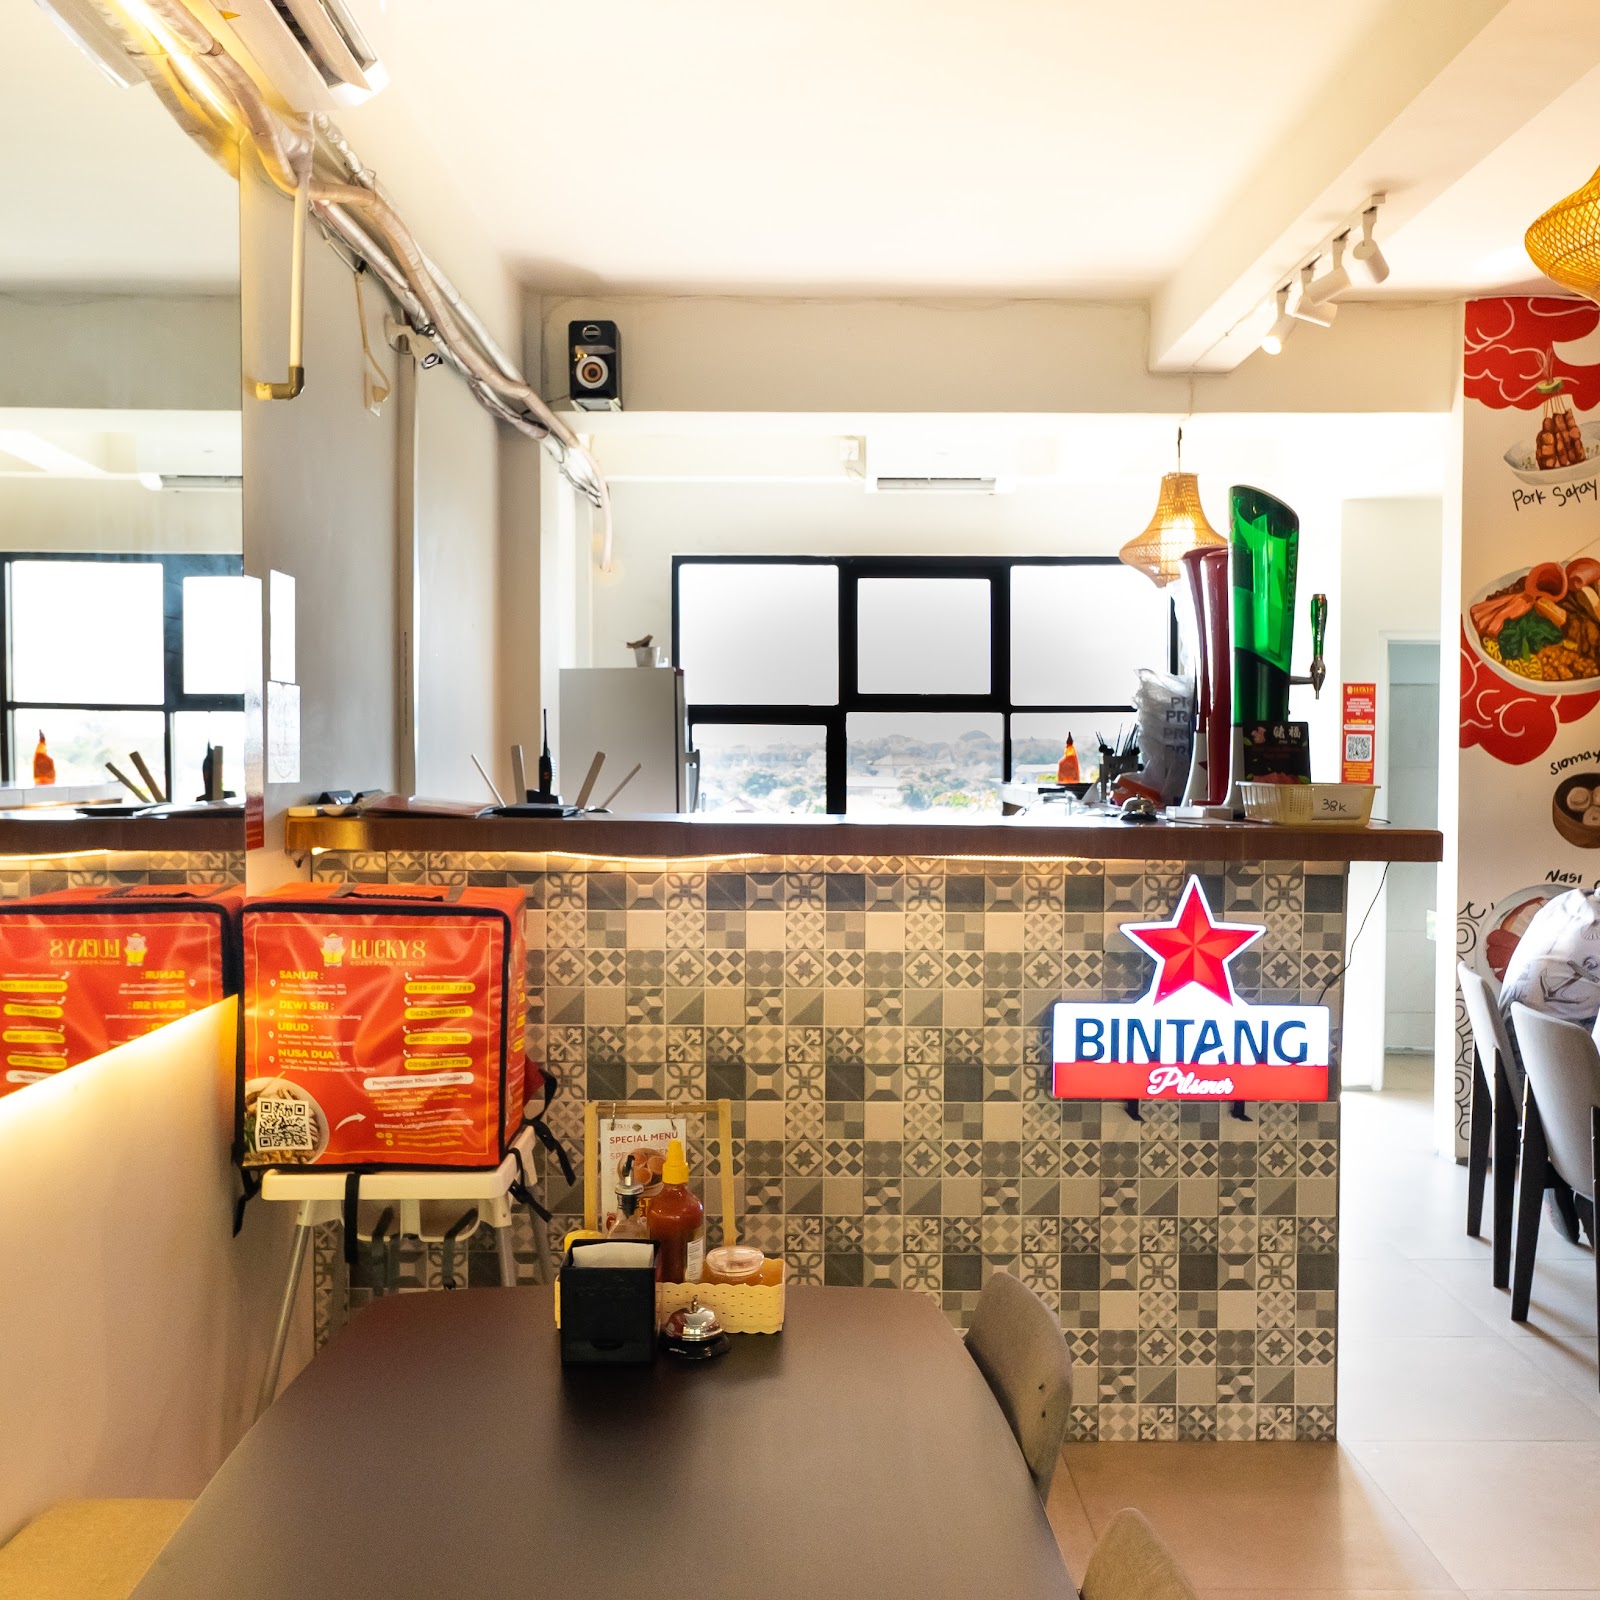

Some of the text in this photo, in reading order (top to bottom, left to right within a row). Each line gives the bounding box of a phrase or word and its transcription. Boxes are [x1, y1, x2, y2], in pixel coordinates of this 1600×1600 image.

[1512, 479, 1598, 511] Pork Satay
[1166, 710, 1189, 722] PR
[1545, 869, 1583, 884] Nasi
[279, 970, 319, 980] SANUR
[279, 1000, 307, 1010] DEWI
[310, 1001, 329, 1011] SRI
[277, 1022, 309, 1032] UBUD
[1075, 1018, 1308, 1064] BINTANG
[277, 1049, 309, 1058] NUSA
[311, 1051, 335, 1060] DUA
[1147, 1066, 1235, 1095] Pilsener
[609, 1131, 679, 1144] SPECIAL MENU
